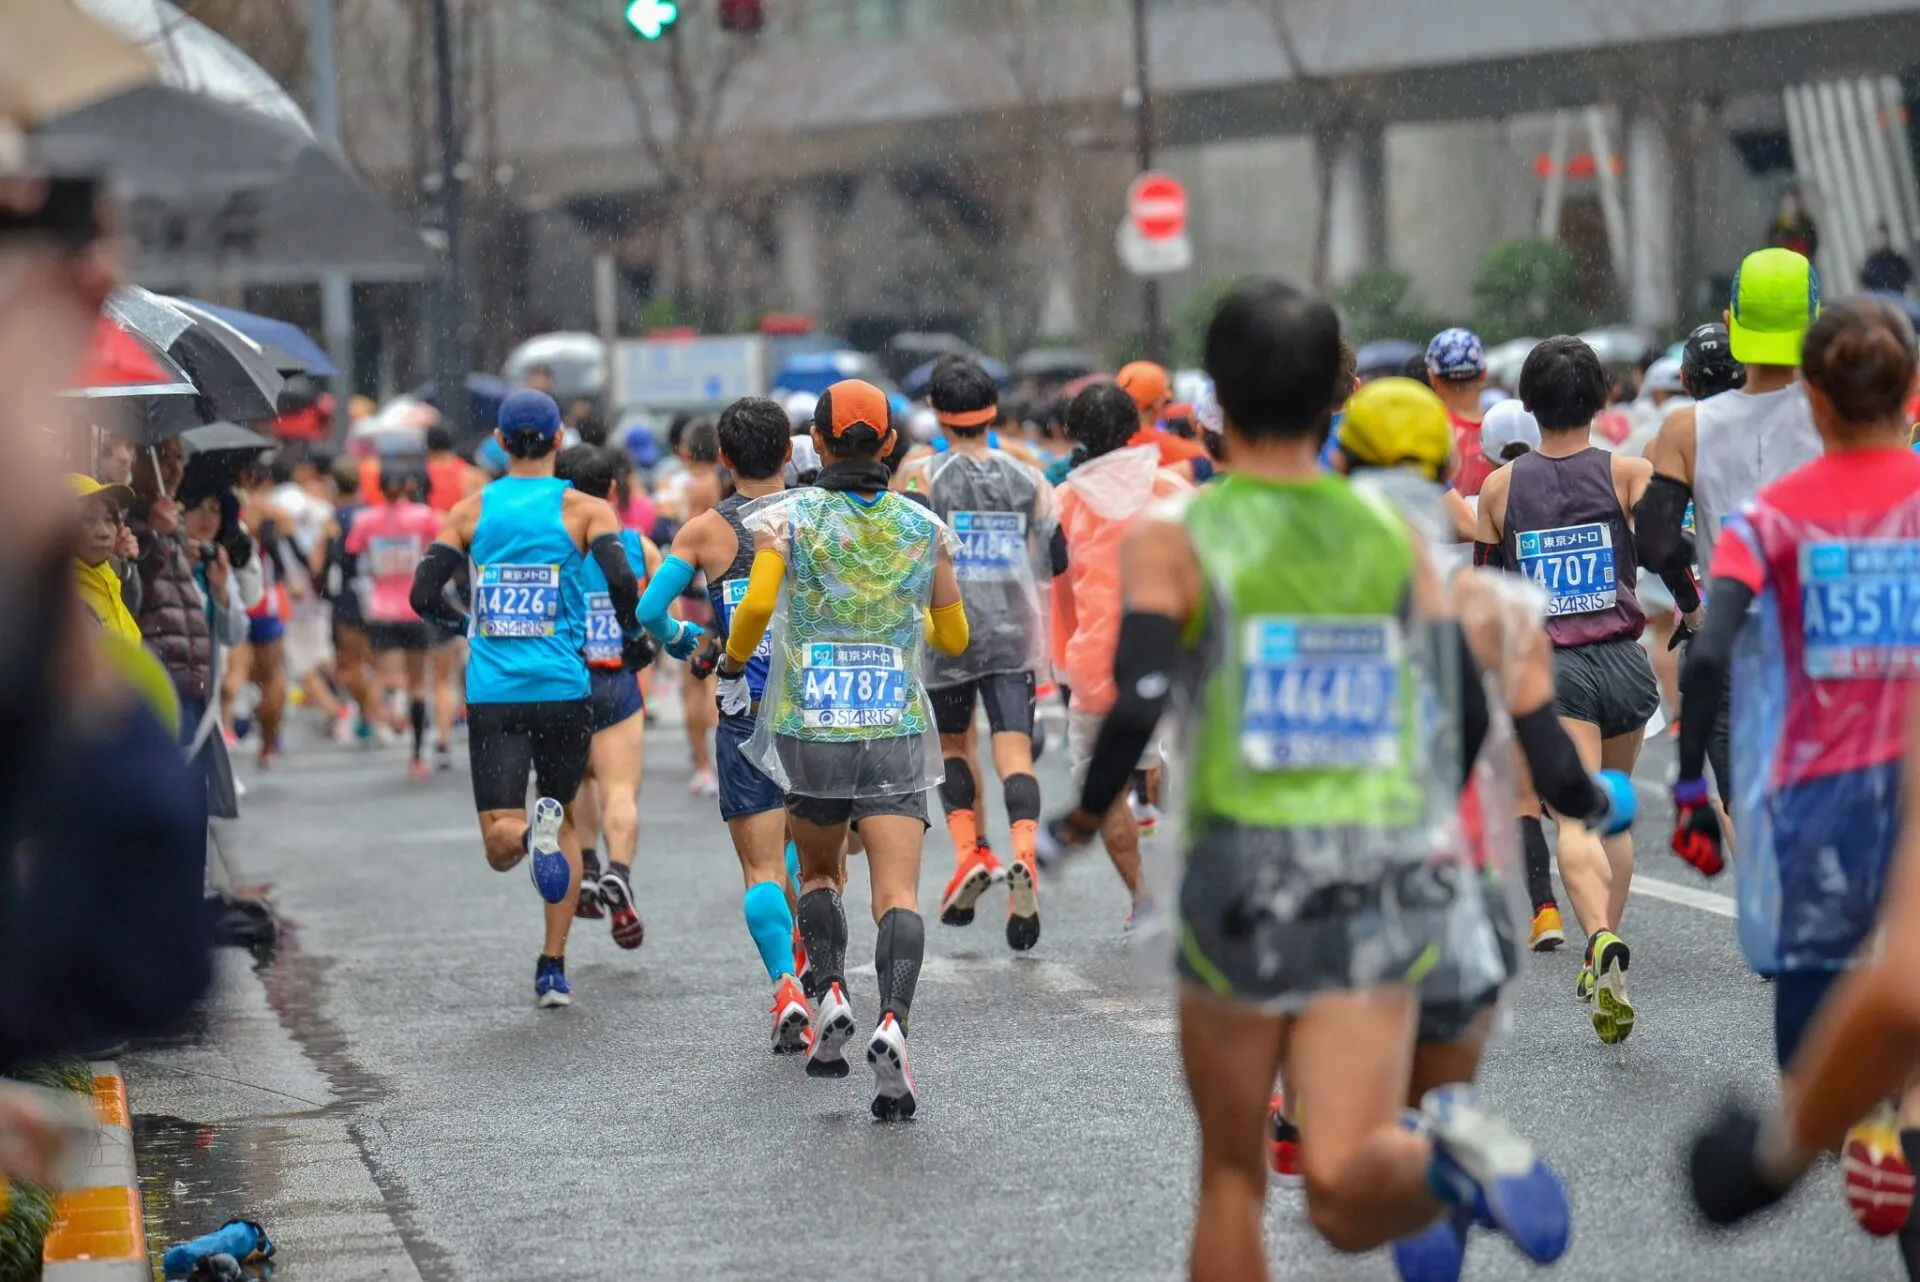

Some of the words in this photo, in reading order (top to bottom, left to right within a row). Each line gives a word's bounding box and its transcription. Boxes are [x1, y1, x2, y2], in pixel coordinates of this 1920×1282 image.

[1543, 532, 1599, 548] 東京メトロ
[478, 588, 545, 614] A4226
[837, 650, 890, 663] 東京メトロ
[805, 671, 889, 700] A4787
